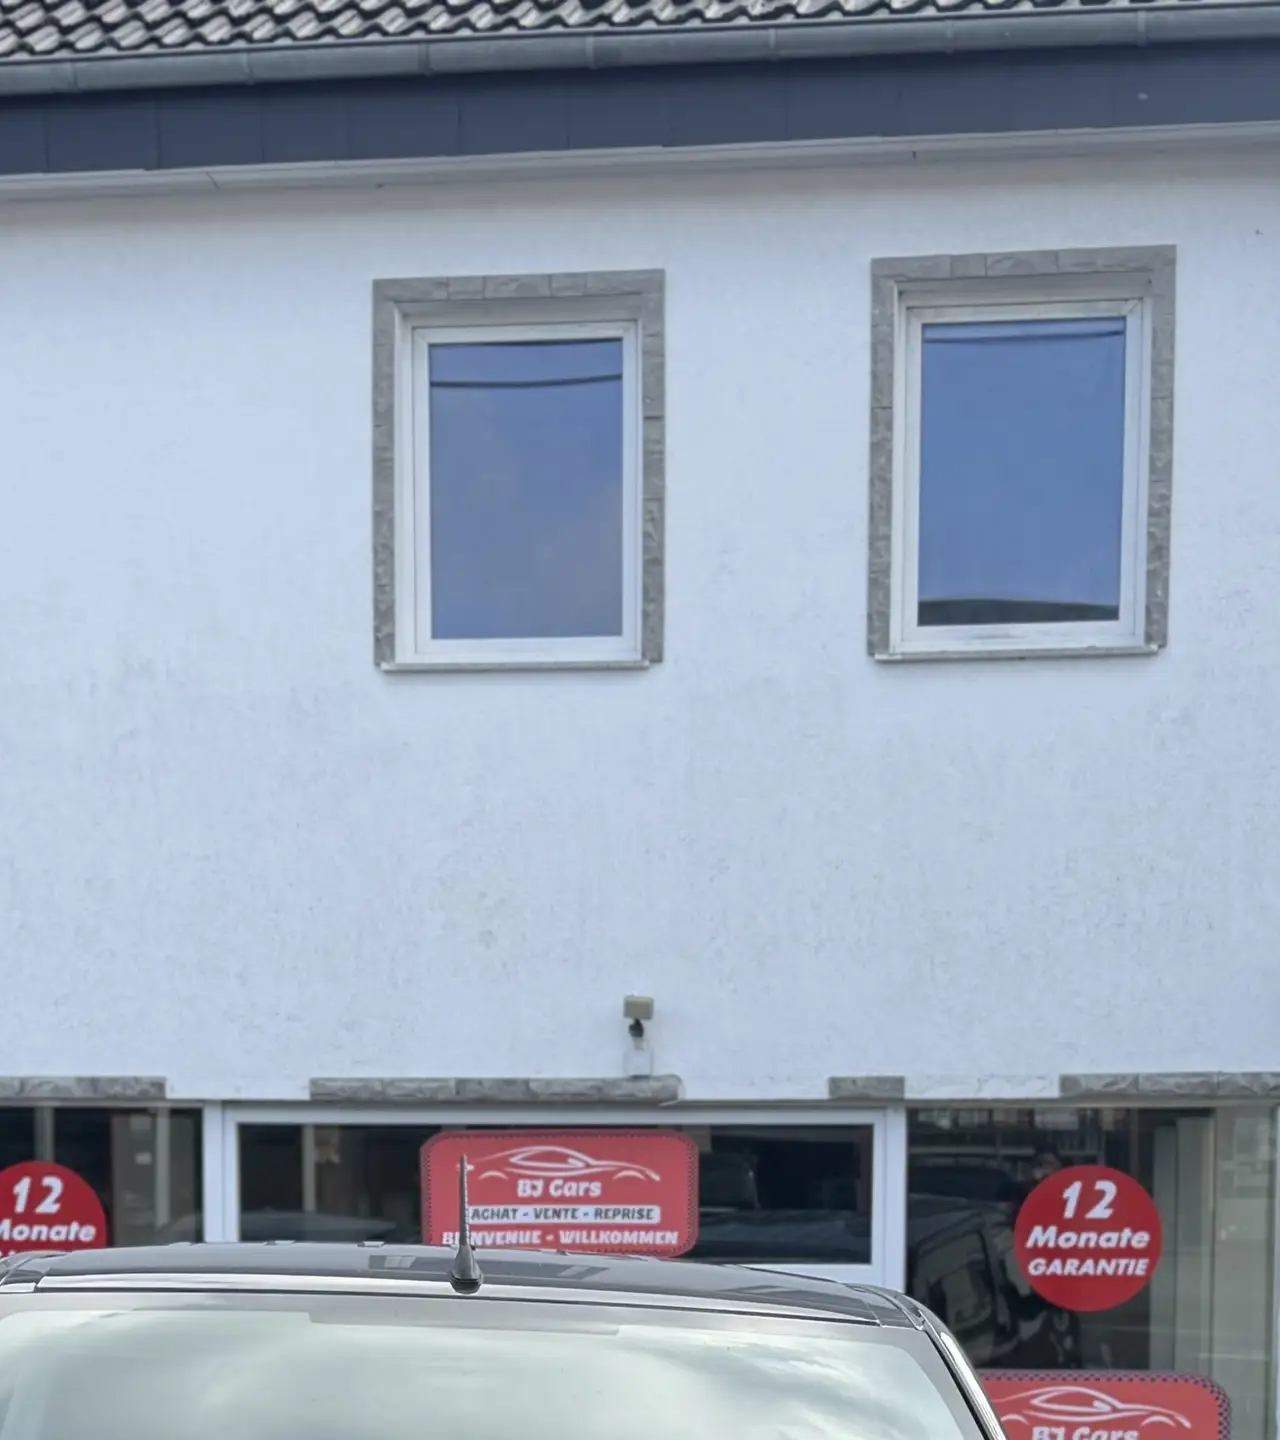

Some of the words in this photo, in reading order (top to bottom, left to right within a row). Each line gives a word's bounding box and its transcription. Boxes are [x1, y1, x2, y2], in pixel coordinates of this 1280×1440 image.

[12, 1175, 64, 1215] 12
[517, 1179, 544, 1198] BJ
[549, 1179, 602, 1198] Cars
[1062, 1179, 1118, 1220] 12
[471, 1207, 519, 1221] ACHAT
[534, 1207, 580, 1220] VENTE
[594, 1207, 654, 1221] REPRISE
[442, 1230, 542, 1246] BINVENUE
[559, 1230, 679, 1246] WILLKOMMEN
[1025, 1225, 1151, 1249] Monate
[1028, 1258, 1150, 1277] GARANTIE
